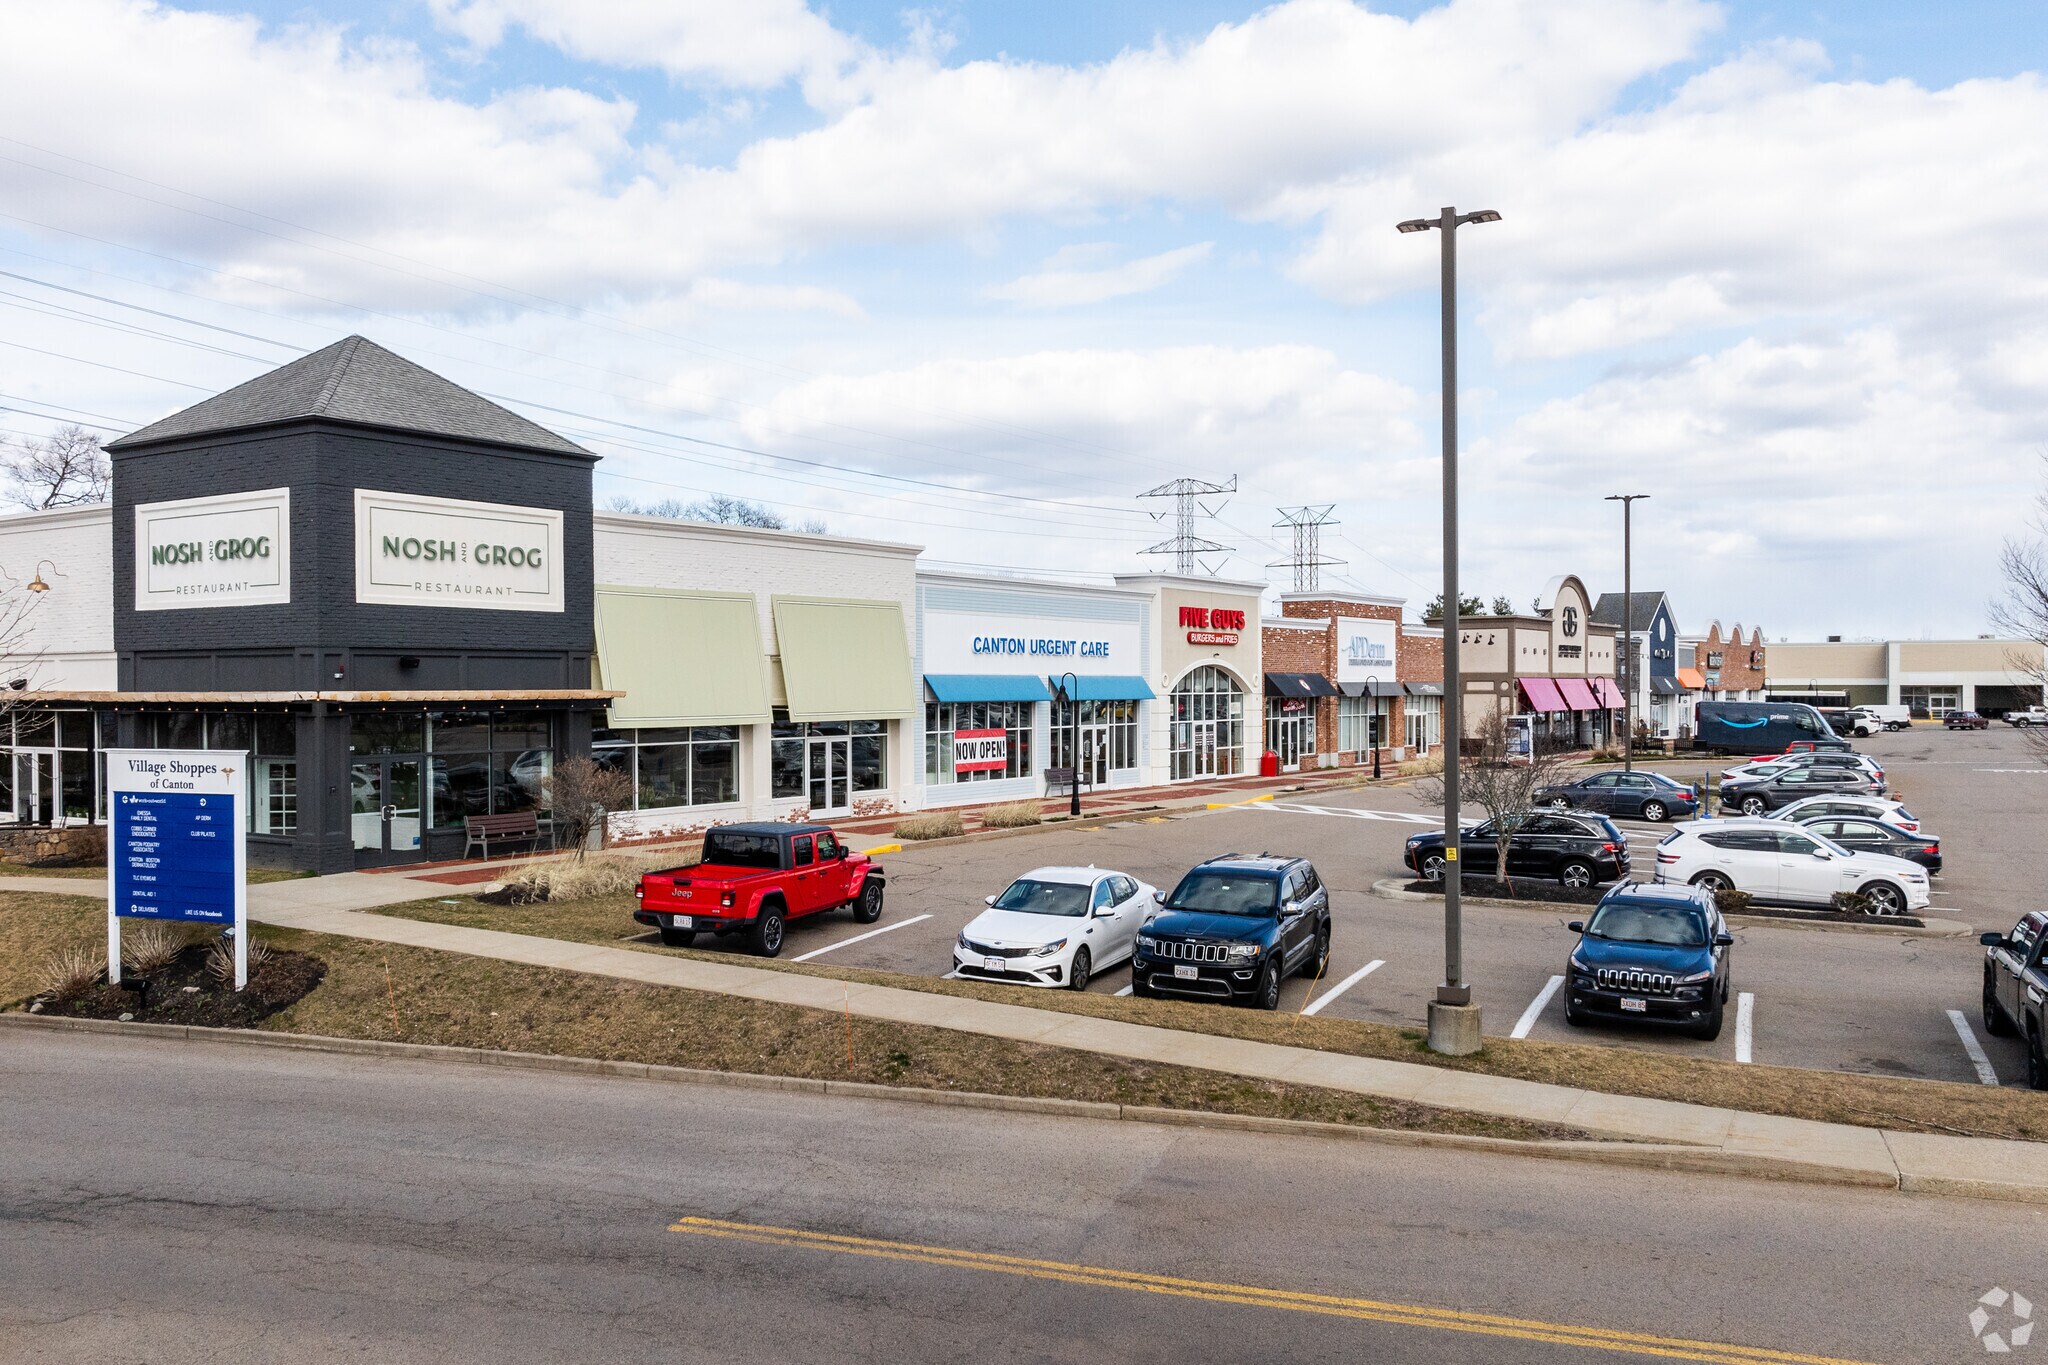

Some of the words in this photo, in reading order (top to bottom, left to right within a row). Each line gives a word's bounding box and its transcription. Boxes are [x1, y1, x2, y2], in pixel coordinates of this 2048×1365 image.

[152, 541, 203, 566] NOSH
[214, 535, 271, 561] GROG
[382, 535, 457, 563] NOSH
[460, 541, 468, 564] AND
[474, 542, 543, 569] GROG
[176, 581, 249, 595] RESTAURANT
[414, 581, 513, 596] RESTAURANT
[1179, 606, 1209, 628] FIVE
[1210, 608, 1246, 631] GUYS
[973, 636, 1026, 654] CANTON
[1030, 639, 1076, 656] URGENT
[1080, 641, 1110, 657] CARE
[1190, 633, 1215, 643] BURGERS
[1224, 635, 1238, 644] FRIES
[955, 741, 977, 761] NOW
[979, 740, 1006, 759] OPEN!
[128, 759, 167, 777] Village
[170, 760, 218, 778] Shoppes
[150, 778, 160, 789] of
[162, 778, 195, 790] Canton
[671, 887, 693, 899] Jeep
